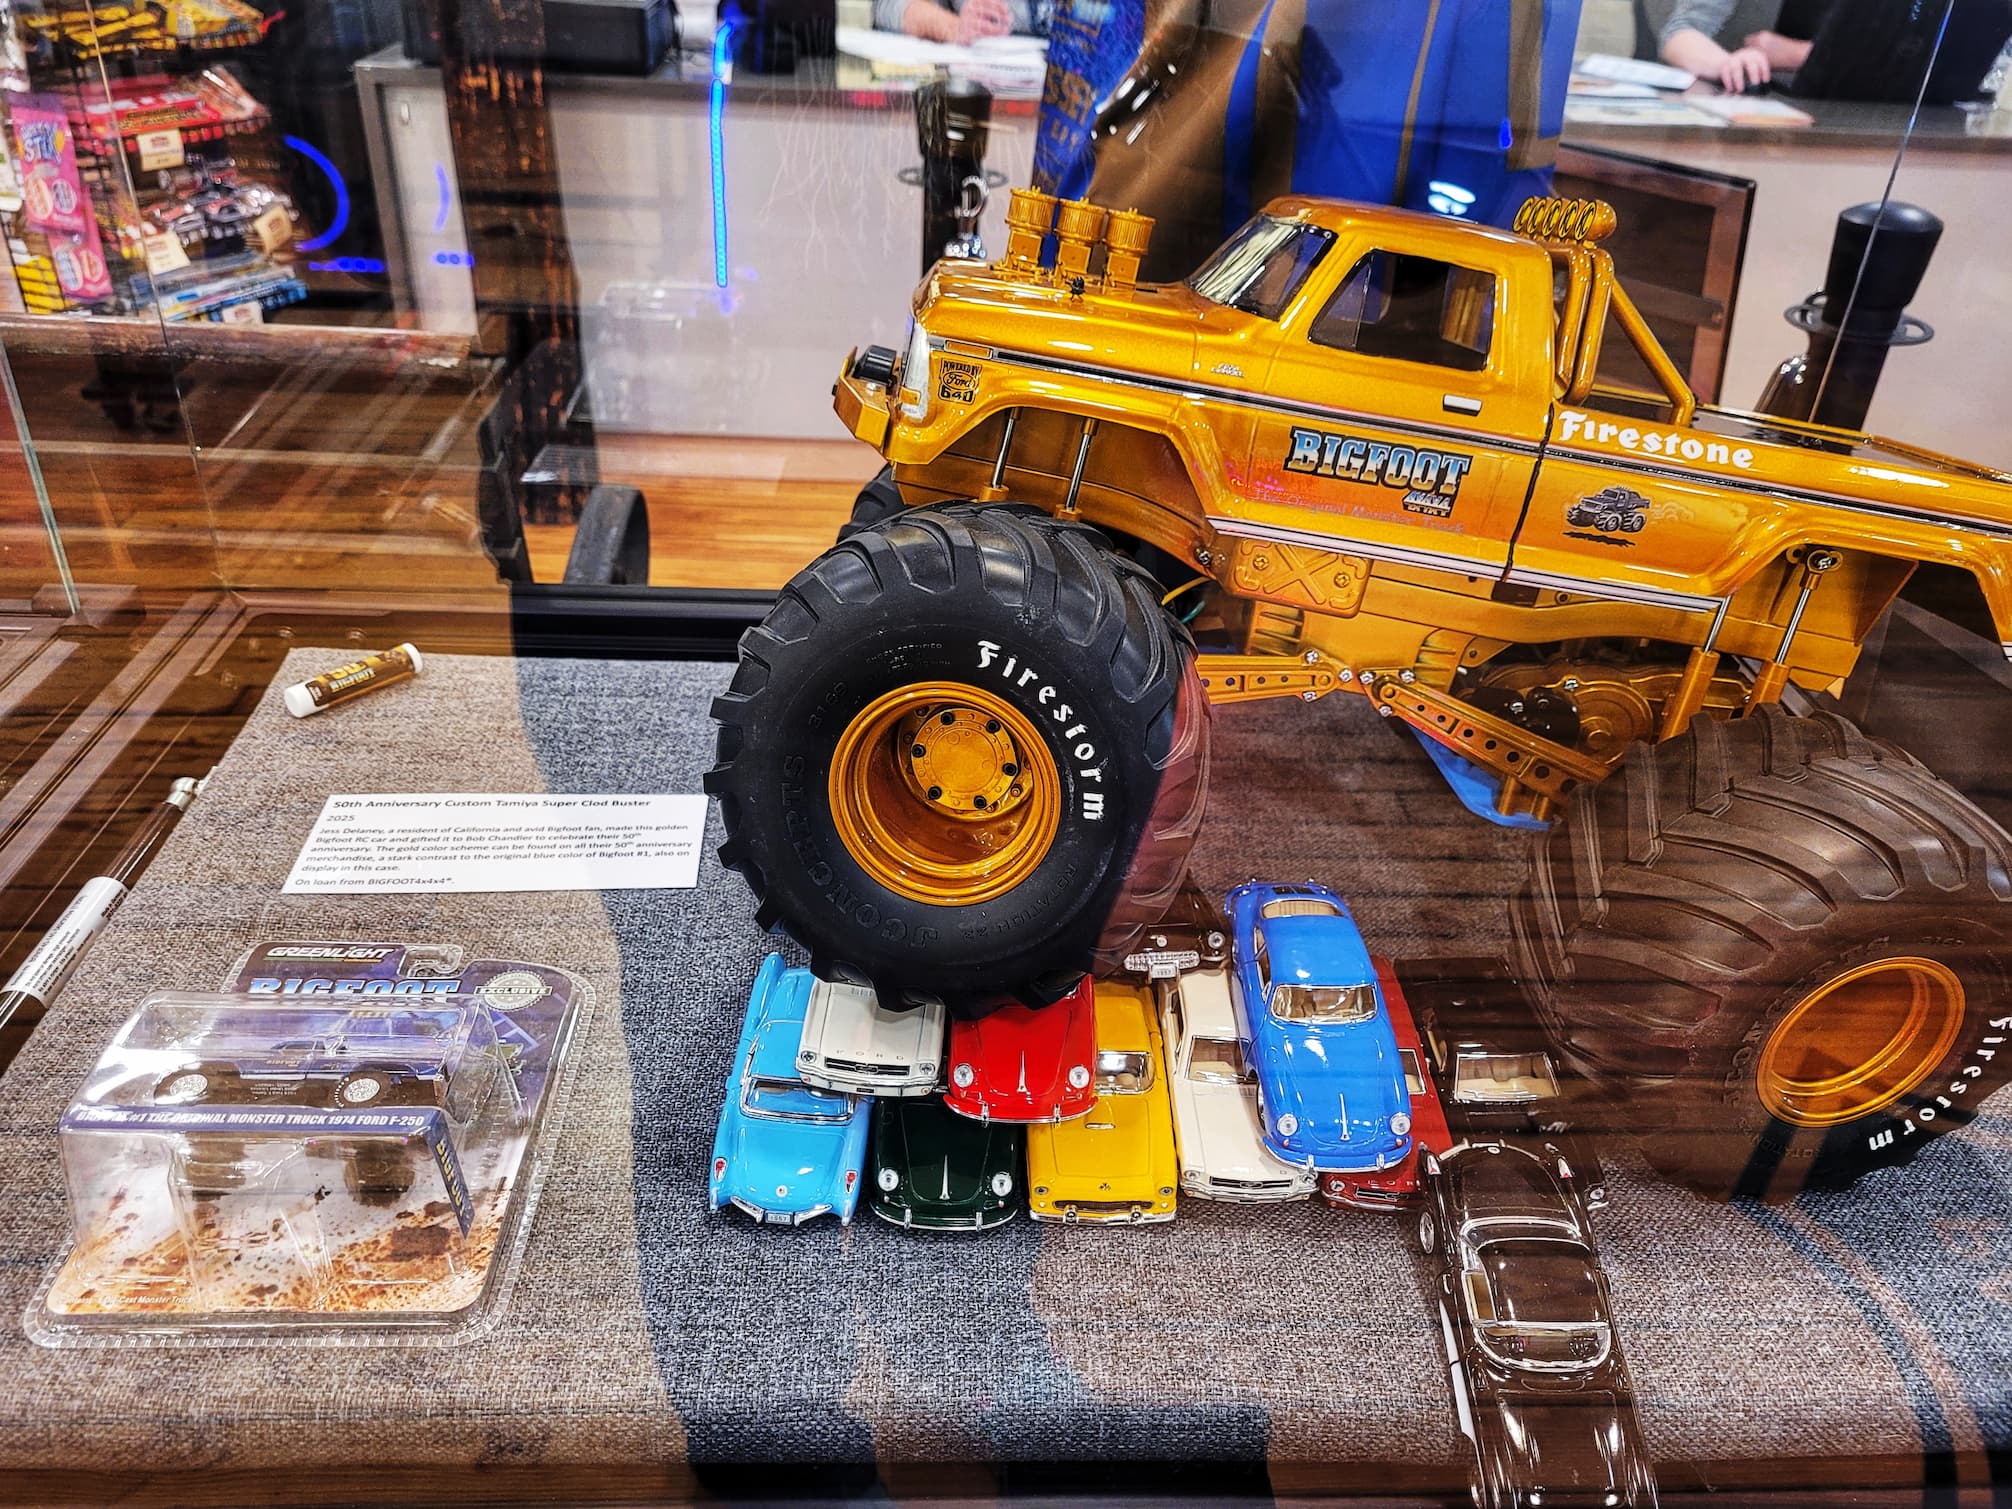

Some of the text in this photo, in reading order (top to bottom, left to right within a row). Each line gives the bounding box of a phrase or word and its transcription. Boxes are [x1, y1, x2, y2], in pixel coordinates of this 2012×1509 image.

[946, 373, 971, 387] Ford
[941, 384, 974, 402] 640
[1559, 410, 1754, 469] Firestone
[1285, 428, 1472, 496] BIGFOOT
[1286, 493, 1348, 516] Original
[1351, 504, 1416, 526] Monster
[1423, 514, 1465, 533] Truck
[333, 800, 362, 808] 50th
[365, 800, 441, 809] Anniversary
[445, 800, 491, 808] Custom
[496, 800, 538, 808] Tamiya
[542, 800, 577, 808] Super
[343, 827, 386, 835] Delaney,
[315, 836, 352, 844] Bigfoot
[411, 836, 440, 844] gifted
[599, 851, 634, 859] Bigfoot
[301, 864, 339, 872] display
[479, 986, 547, 994] EXCLUSIVE
[226, 1113, 285, 1124] MONSTER
[286, 1115, 329, 1125] TRUCK
[328, 1115, 355, 1125] 1974
[356, 1116, 388, 1126] FORD
[389, 1116, 424, 1126] F-250
[139, 1296, 170, 1304] Monster
